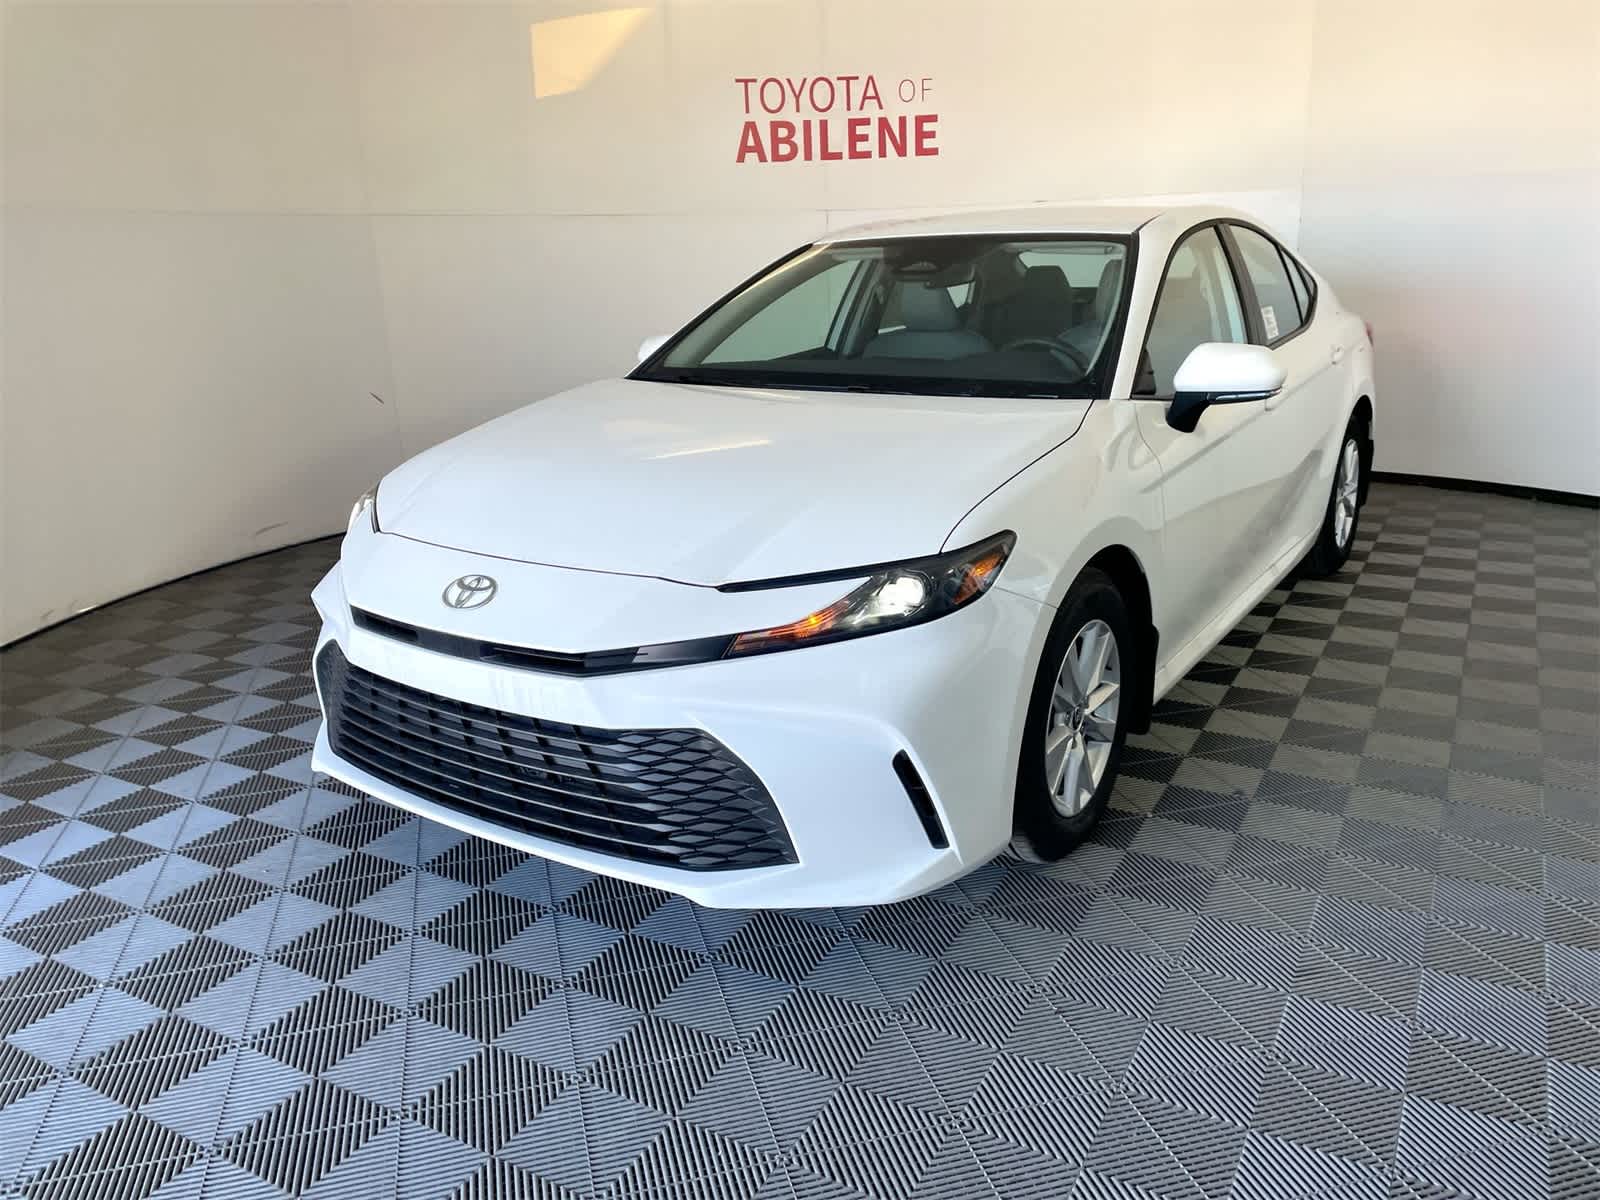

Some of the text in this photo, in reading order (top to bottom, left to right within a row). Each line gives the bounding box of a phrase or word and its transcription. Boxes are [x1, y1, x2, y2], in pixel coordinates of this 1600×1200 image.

[735, 75, 933, 114] TOYOTA OF
[735, 114, 939, 163] ABILENE
